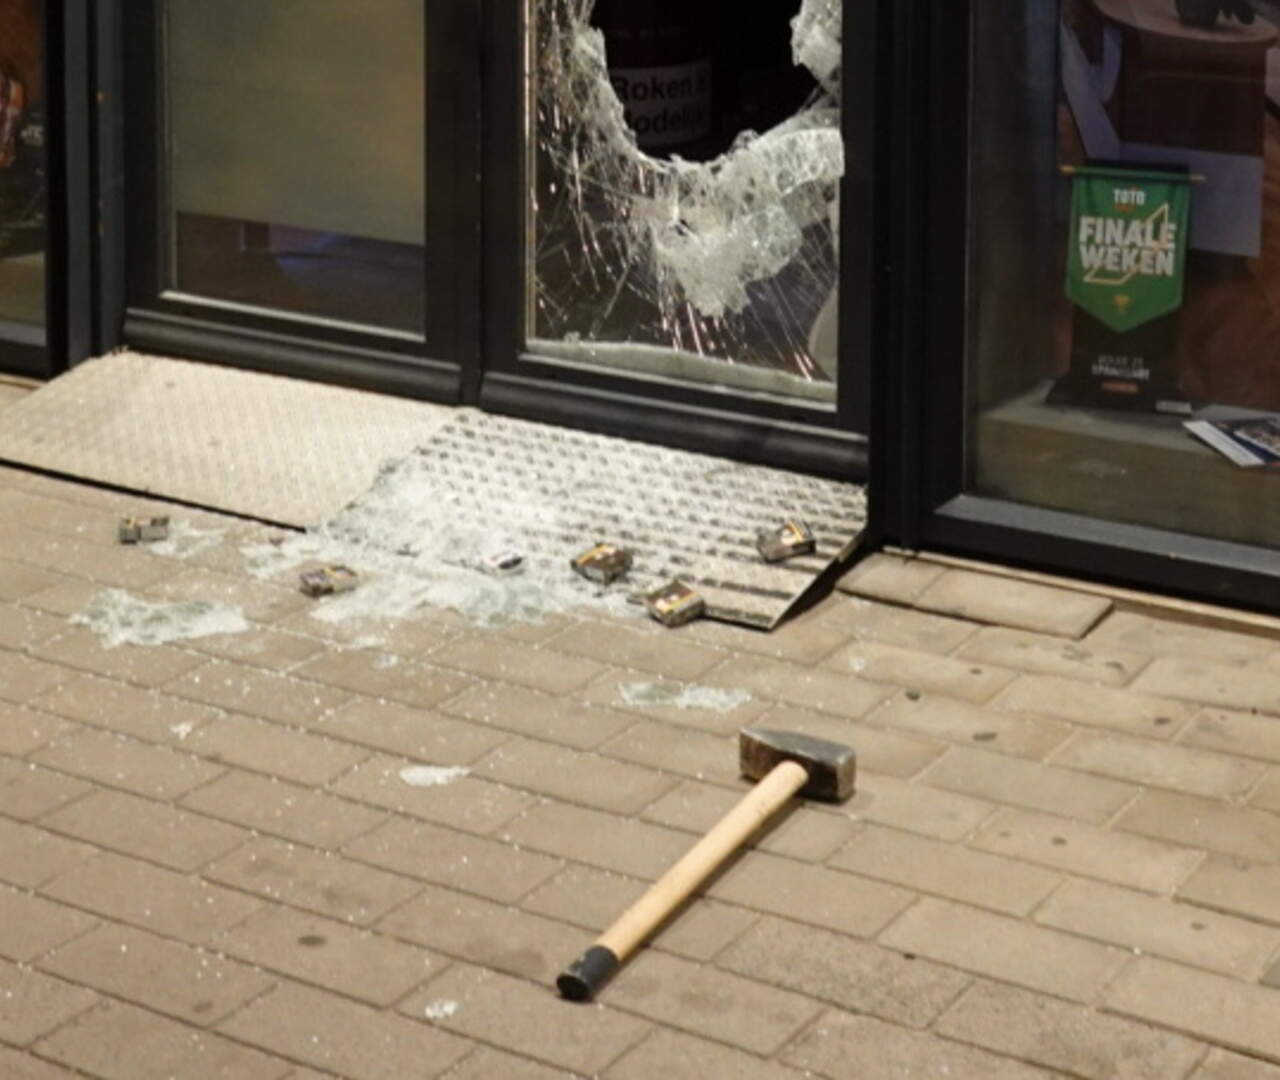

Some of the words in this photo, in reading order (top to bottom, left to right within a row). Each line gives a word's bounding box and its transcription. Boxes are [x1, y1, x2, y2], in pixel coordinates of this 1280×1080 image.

[1114, 187, 1145, 206] TOTO
[1080, 215, 1176, 249] FINALE
[1080, 245, 1175, 276] WEKEN
